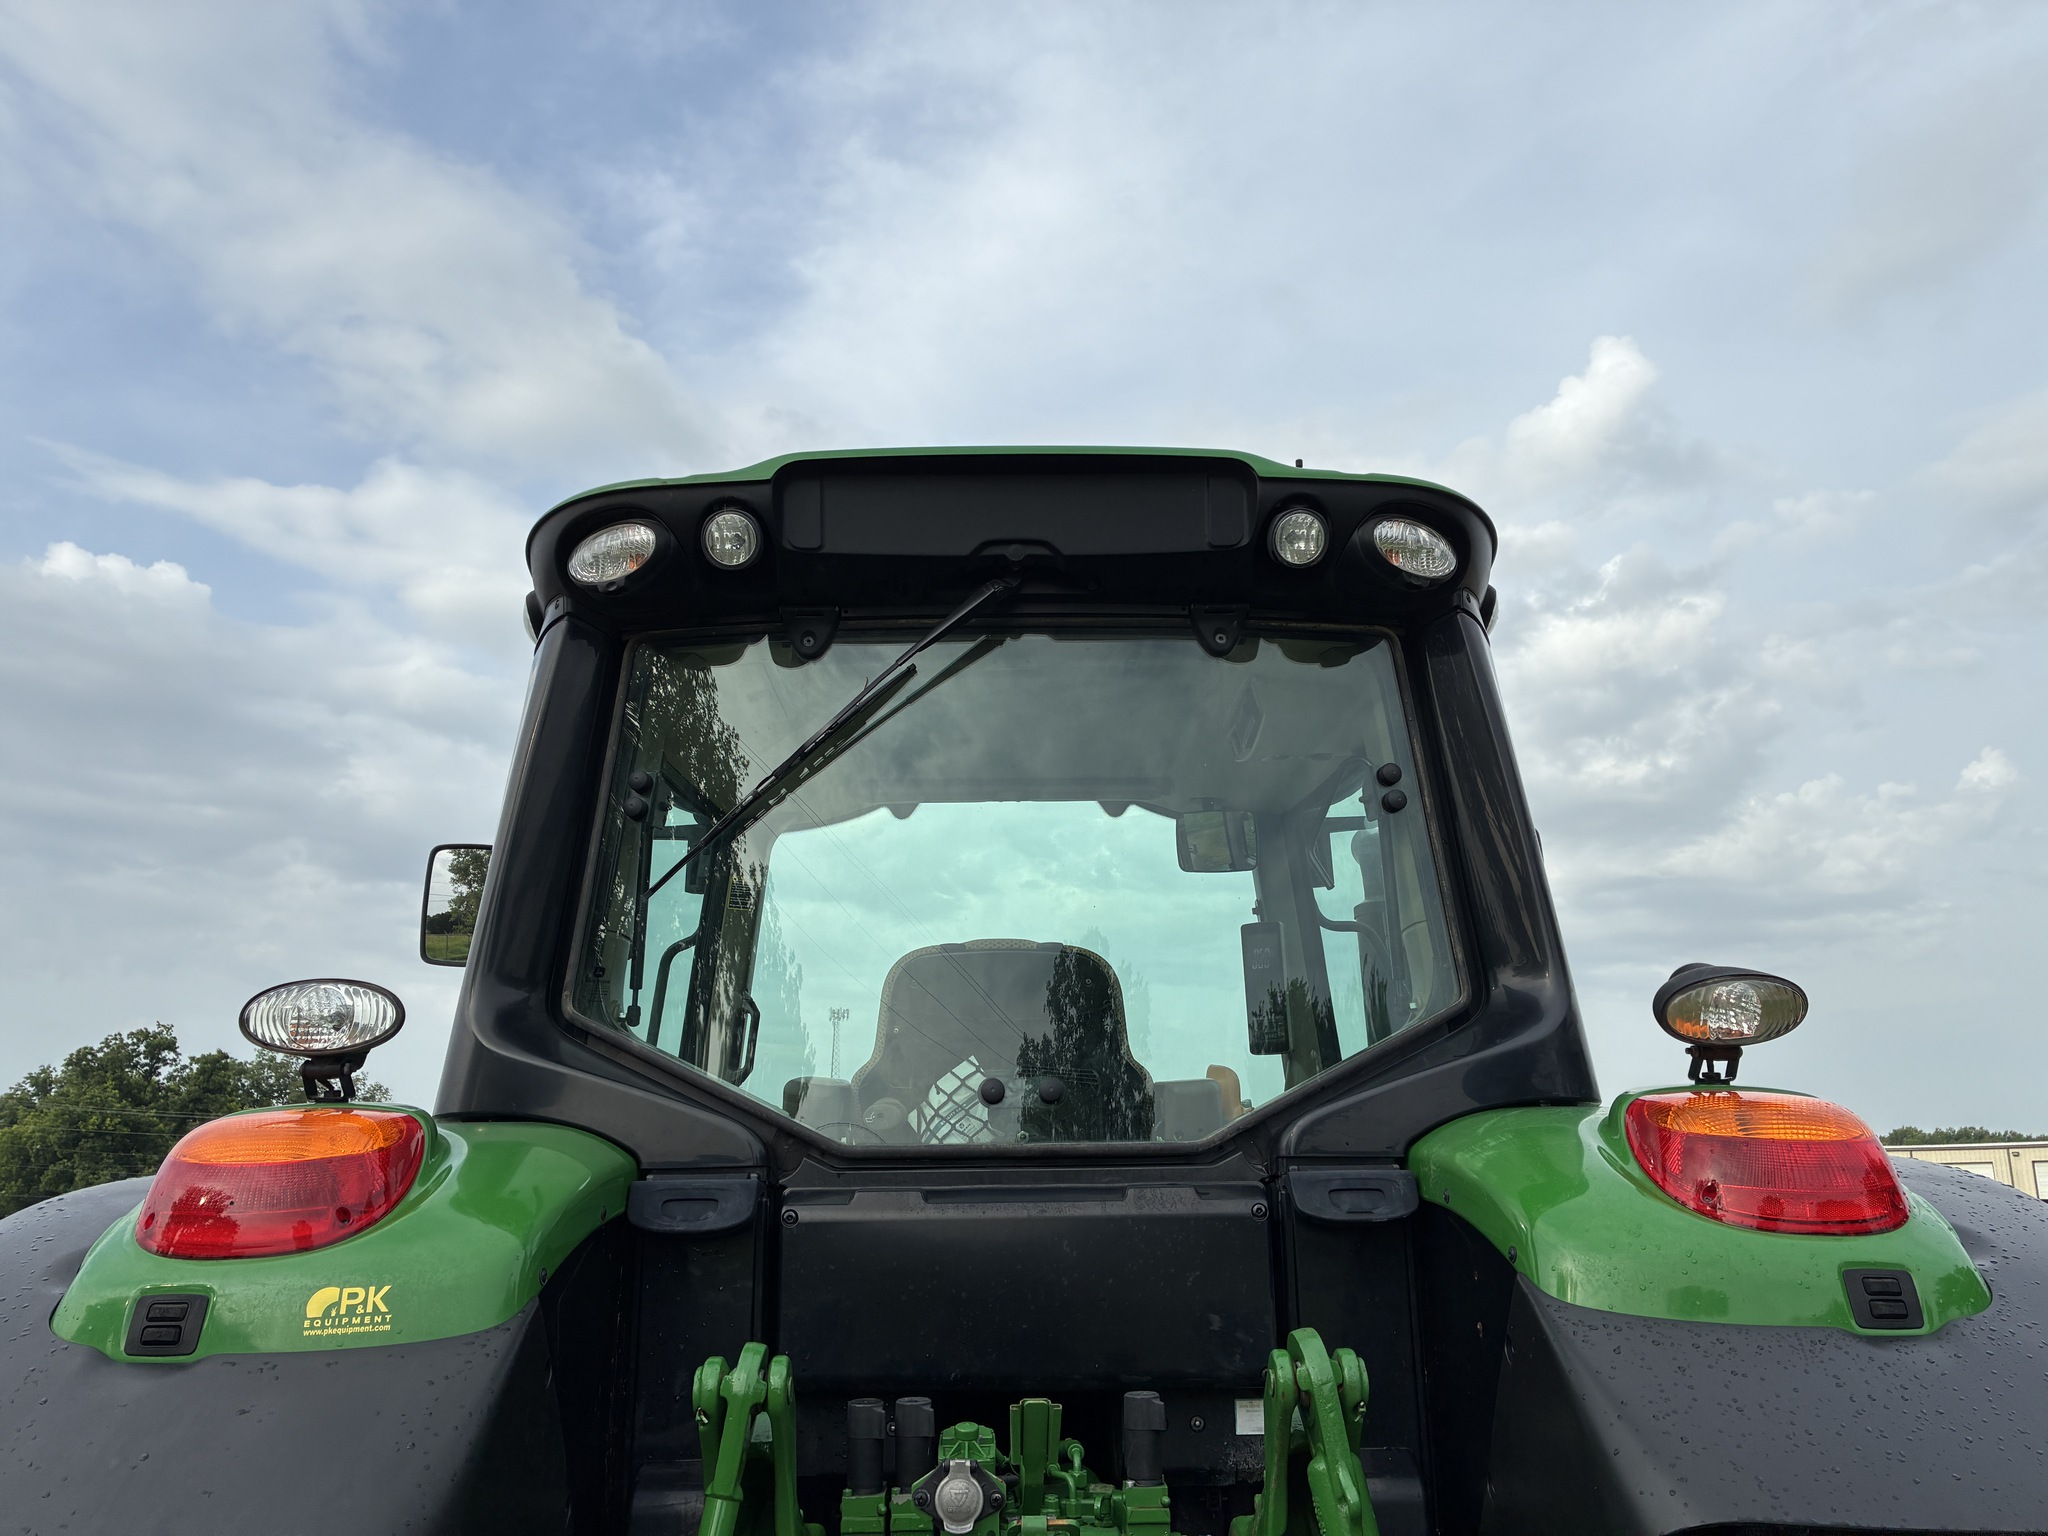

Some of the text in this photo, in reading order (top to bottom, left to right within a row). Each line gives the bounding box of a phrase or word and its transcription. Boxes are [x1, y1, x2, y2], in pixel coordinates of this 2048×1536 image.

[340, 1285, 392, 1314] P&K
[304, 1315, 392, 1327] EQUIPMENT
[303, 1324, 391, 1336] www.pkequipment.com
